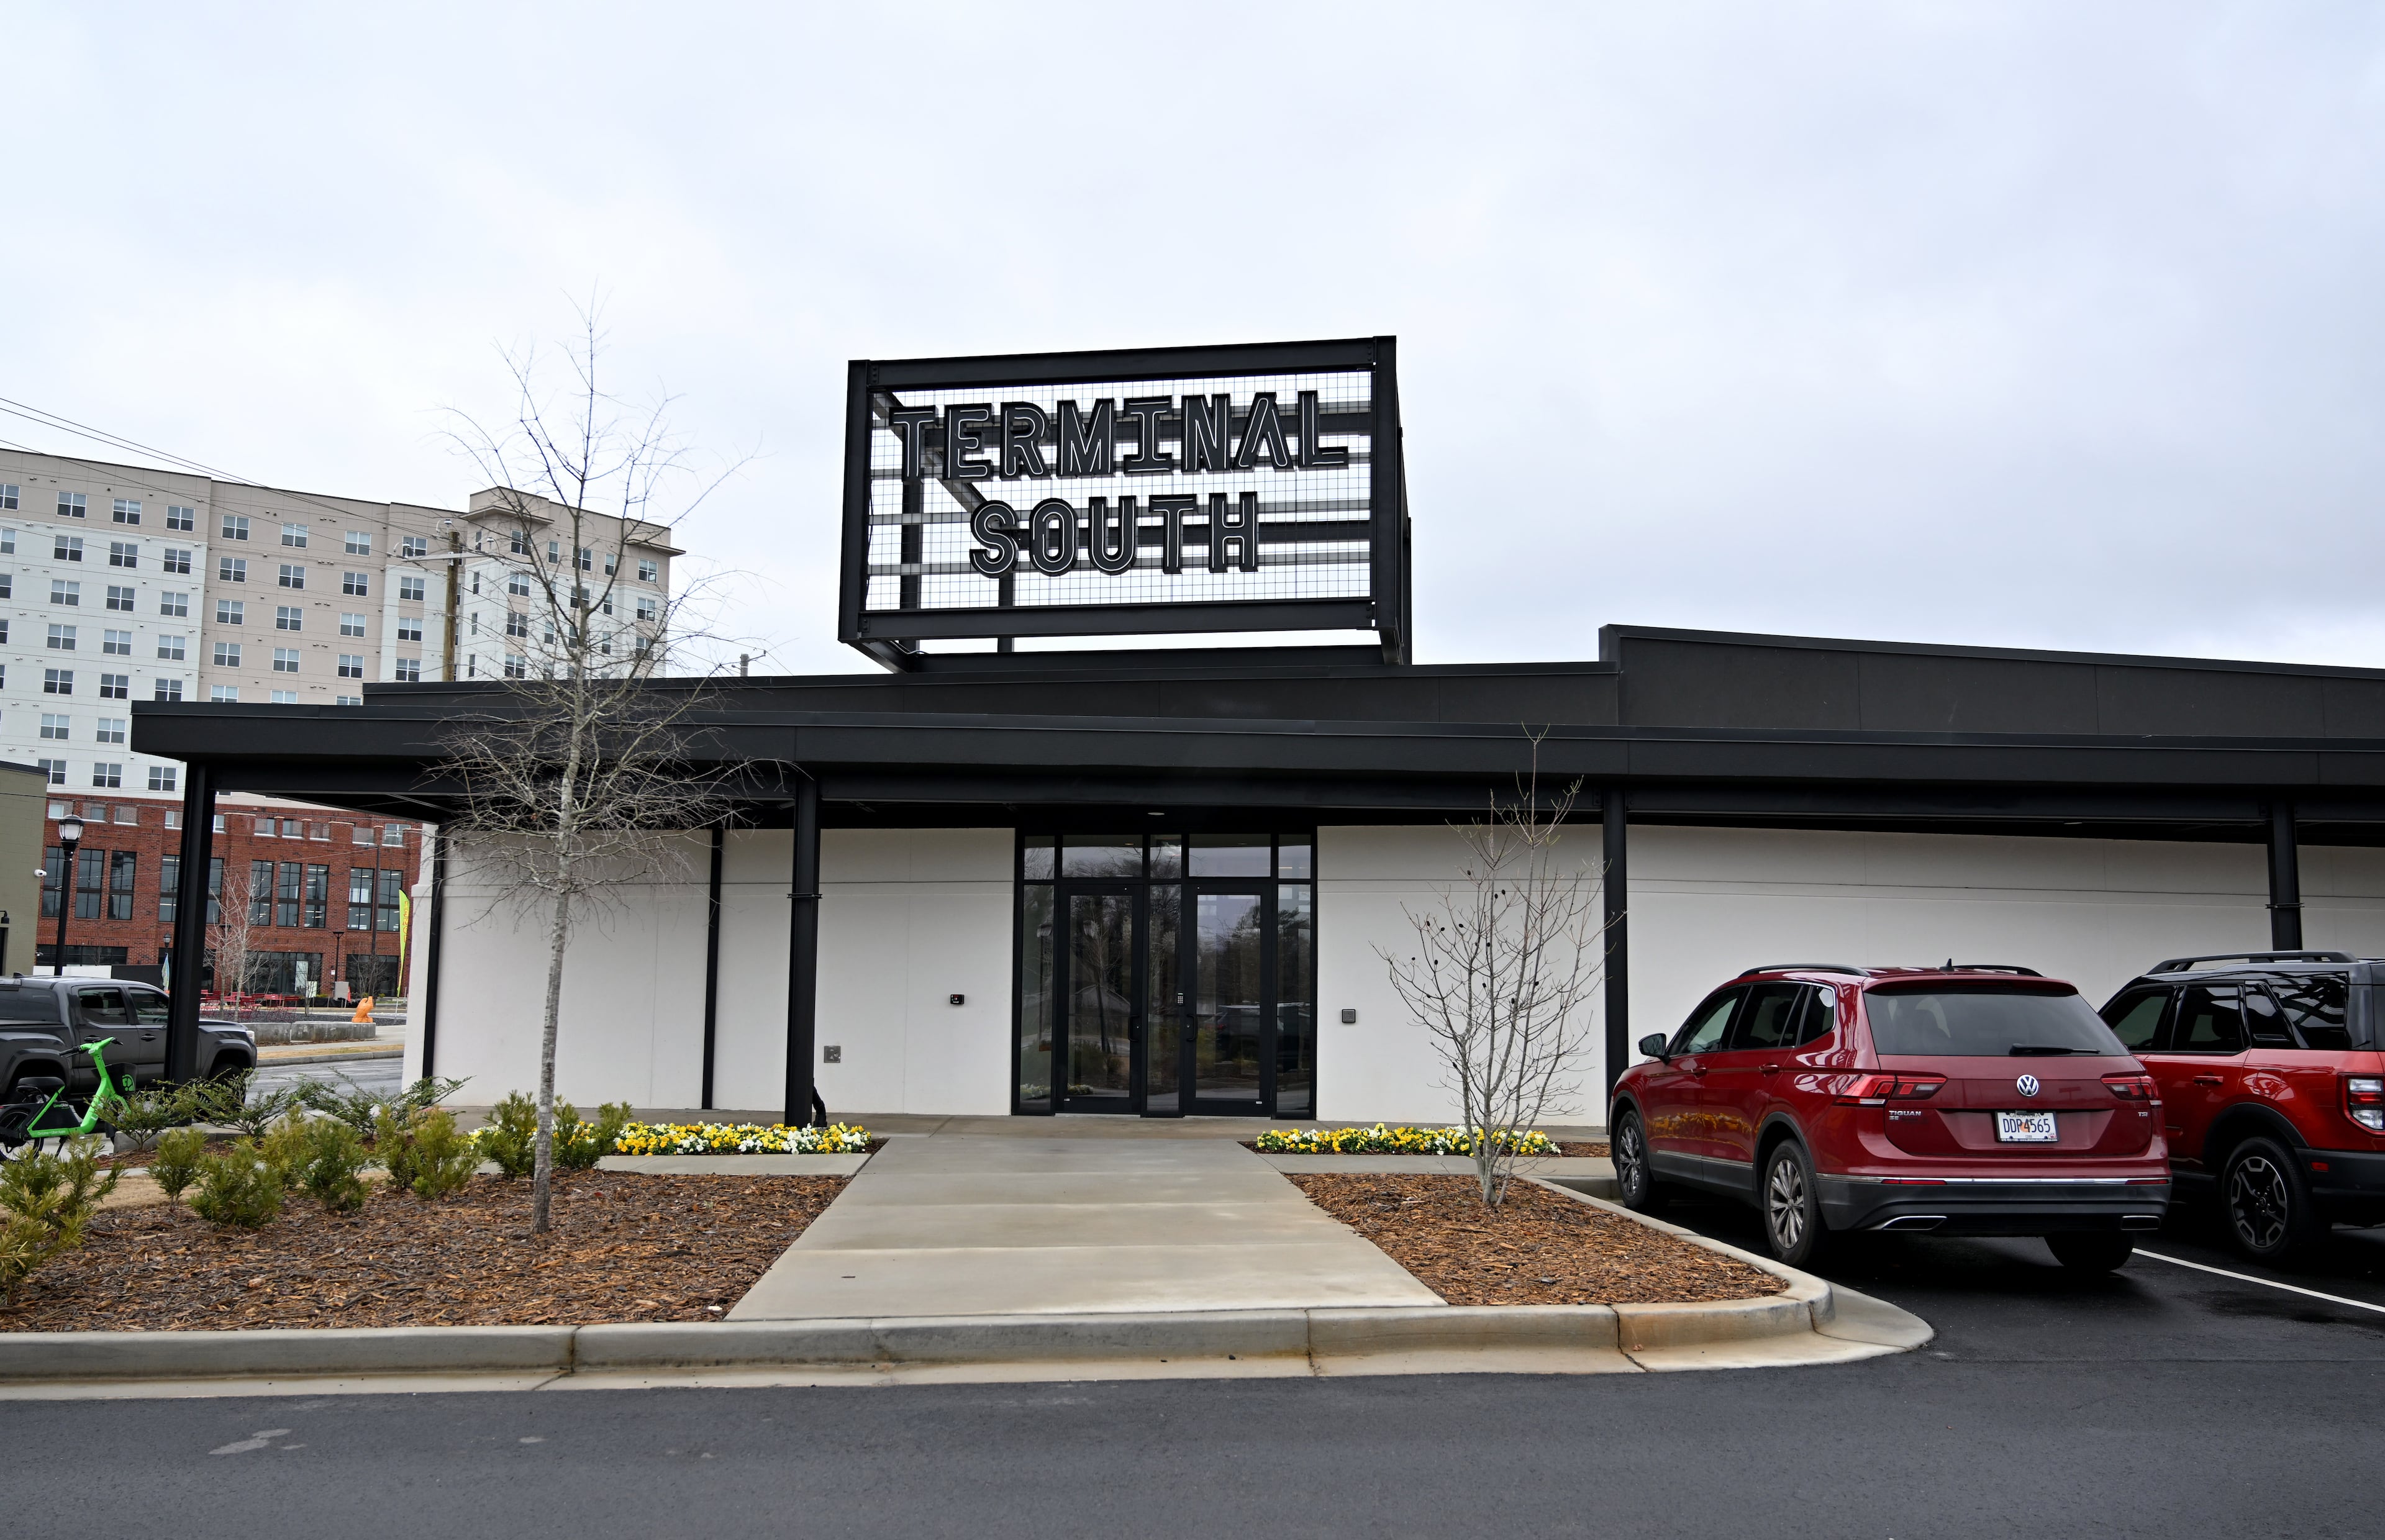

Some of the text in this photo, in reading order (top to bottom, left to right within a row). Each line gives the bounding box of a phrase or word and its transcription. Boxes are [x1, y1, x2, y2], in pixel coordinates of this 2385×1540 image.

[889, 390, 1348, 482] TERMINAL
[970, 491, 1258, 578] SOUTH
[2017, 1074, 2038, 1097] VW
[2003, 1118, 2050, 1133] DDP4565
